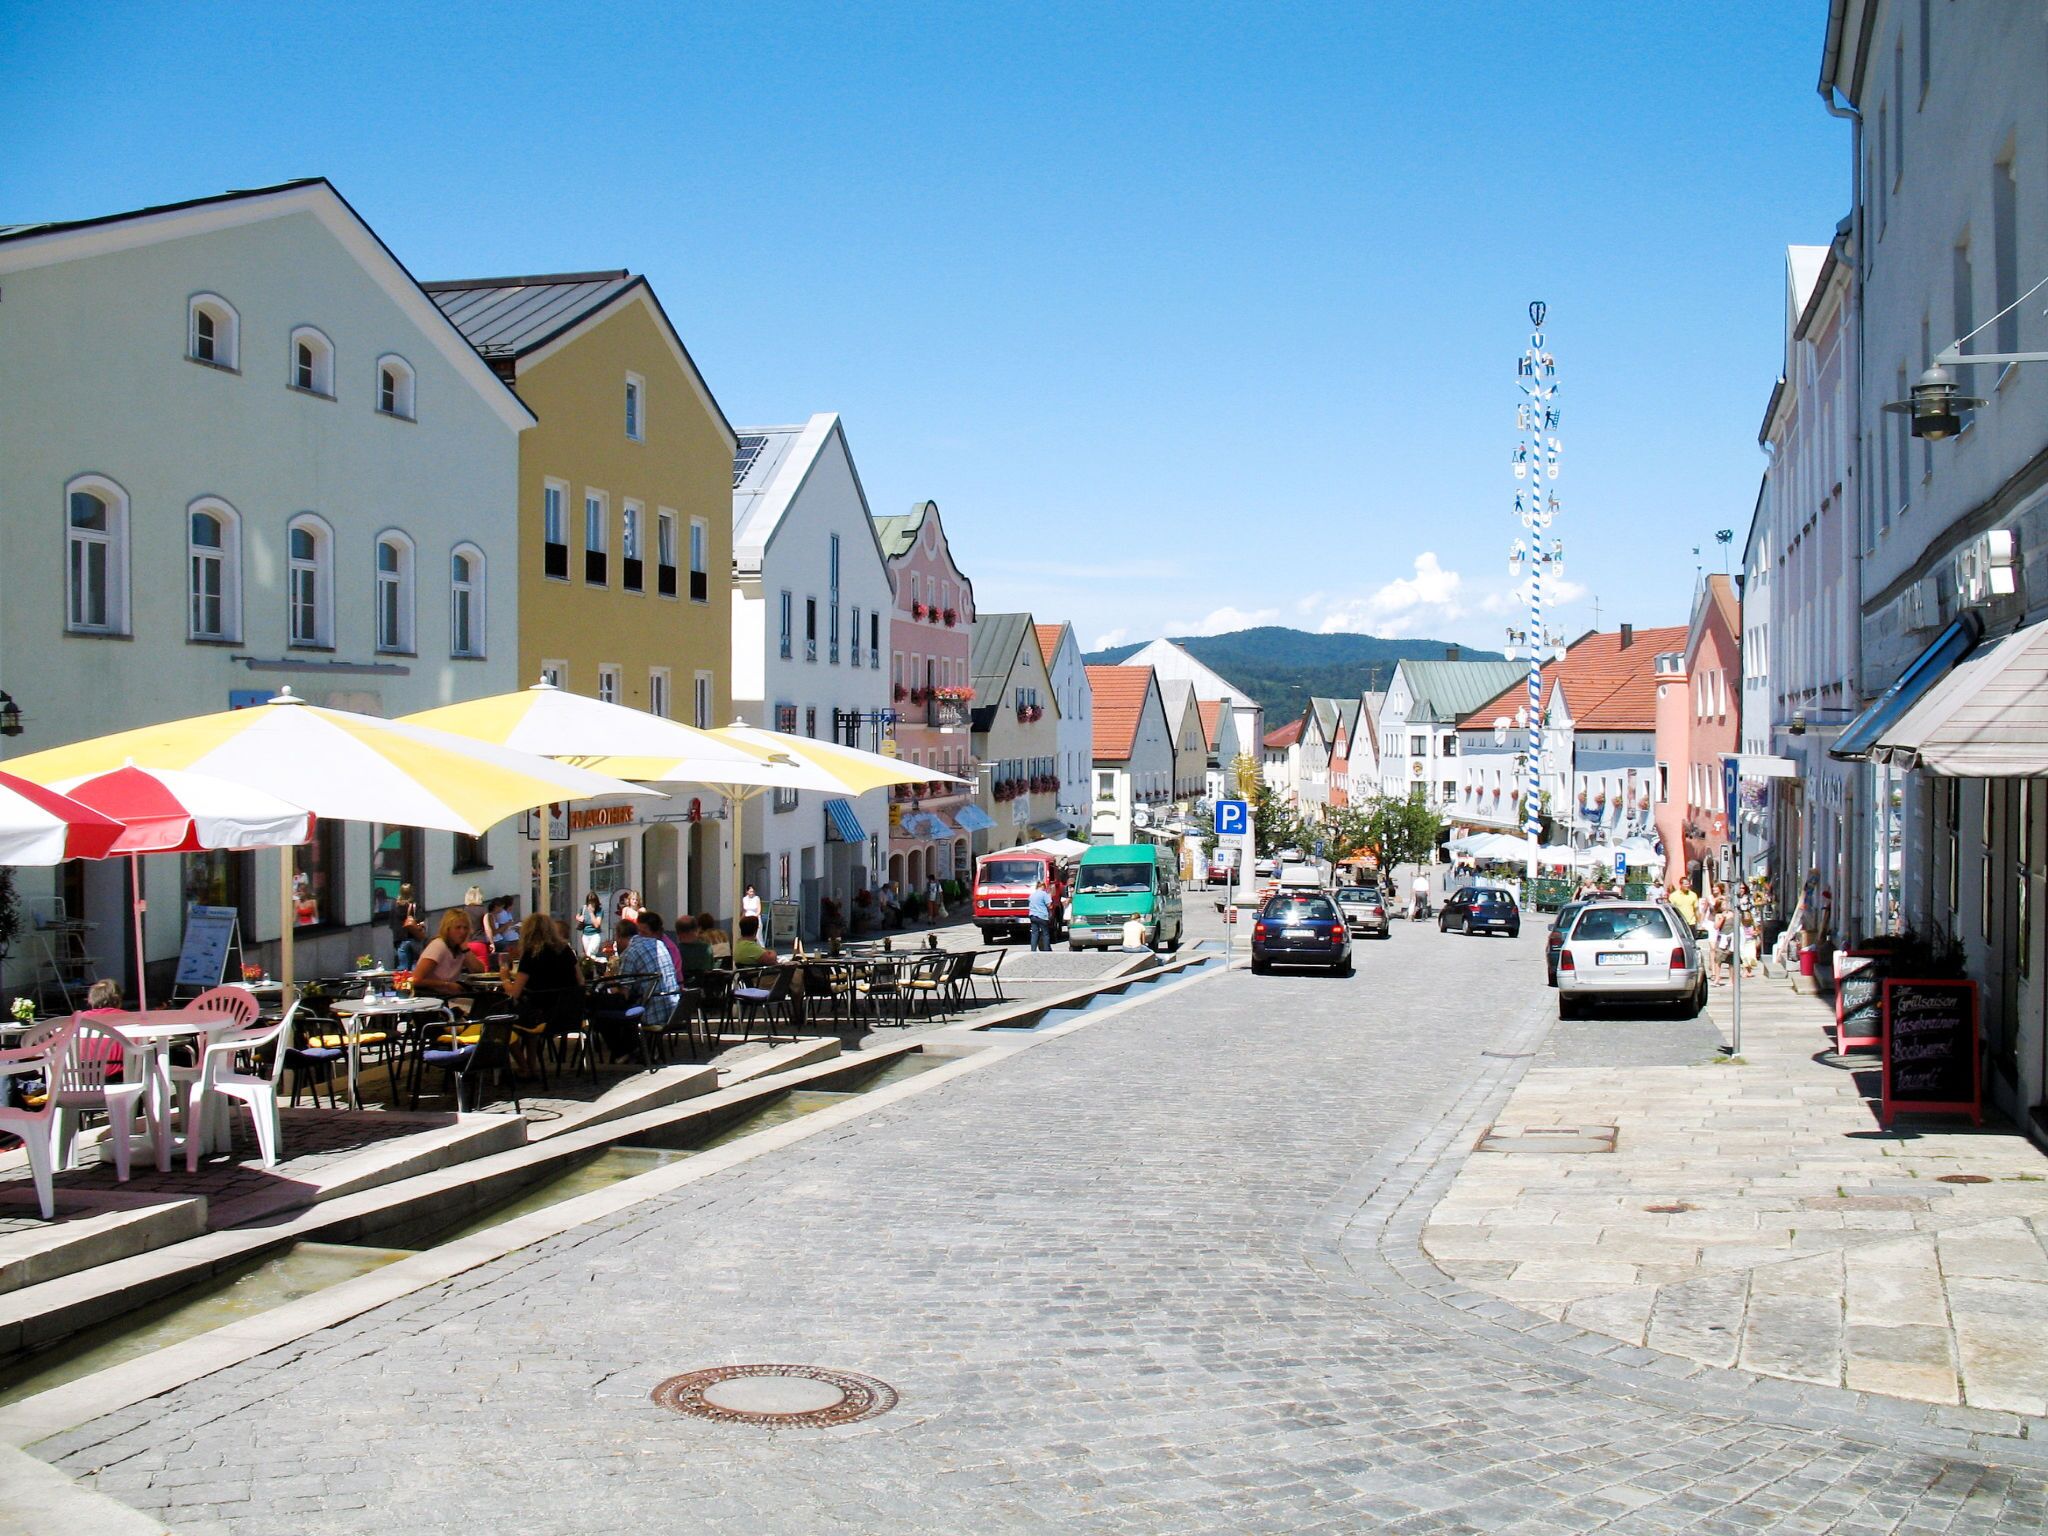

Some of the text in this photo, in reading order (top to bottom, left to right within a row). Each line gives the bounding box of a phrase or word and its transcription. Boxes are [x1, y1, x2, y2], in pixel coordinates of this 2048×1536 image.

[1222, 804, 1240, 830] P
[1616, 854, 1624, 867] P
[1897, 992, 1958, 1015] Grillsaison
